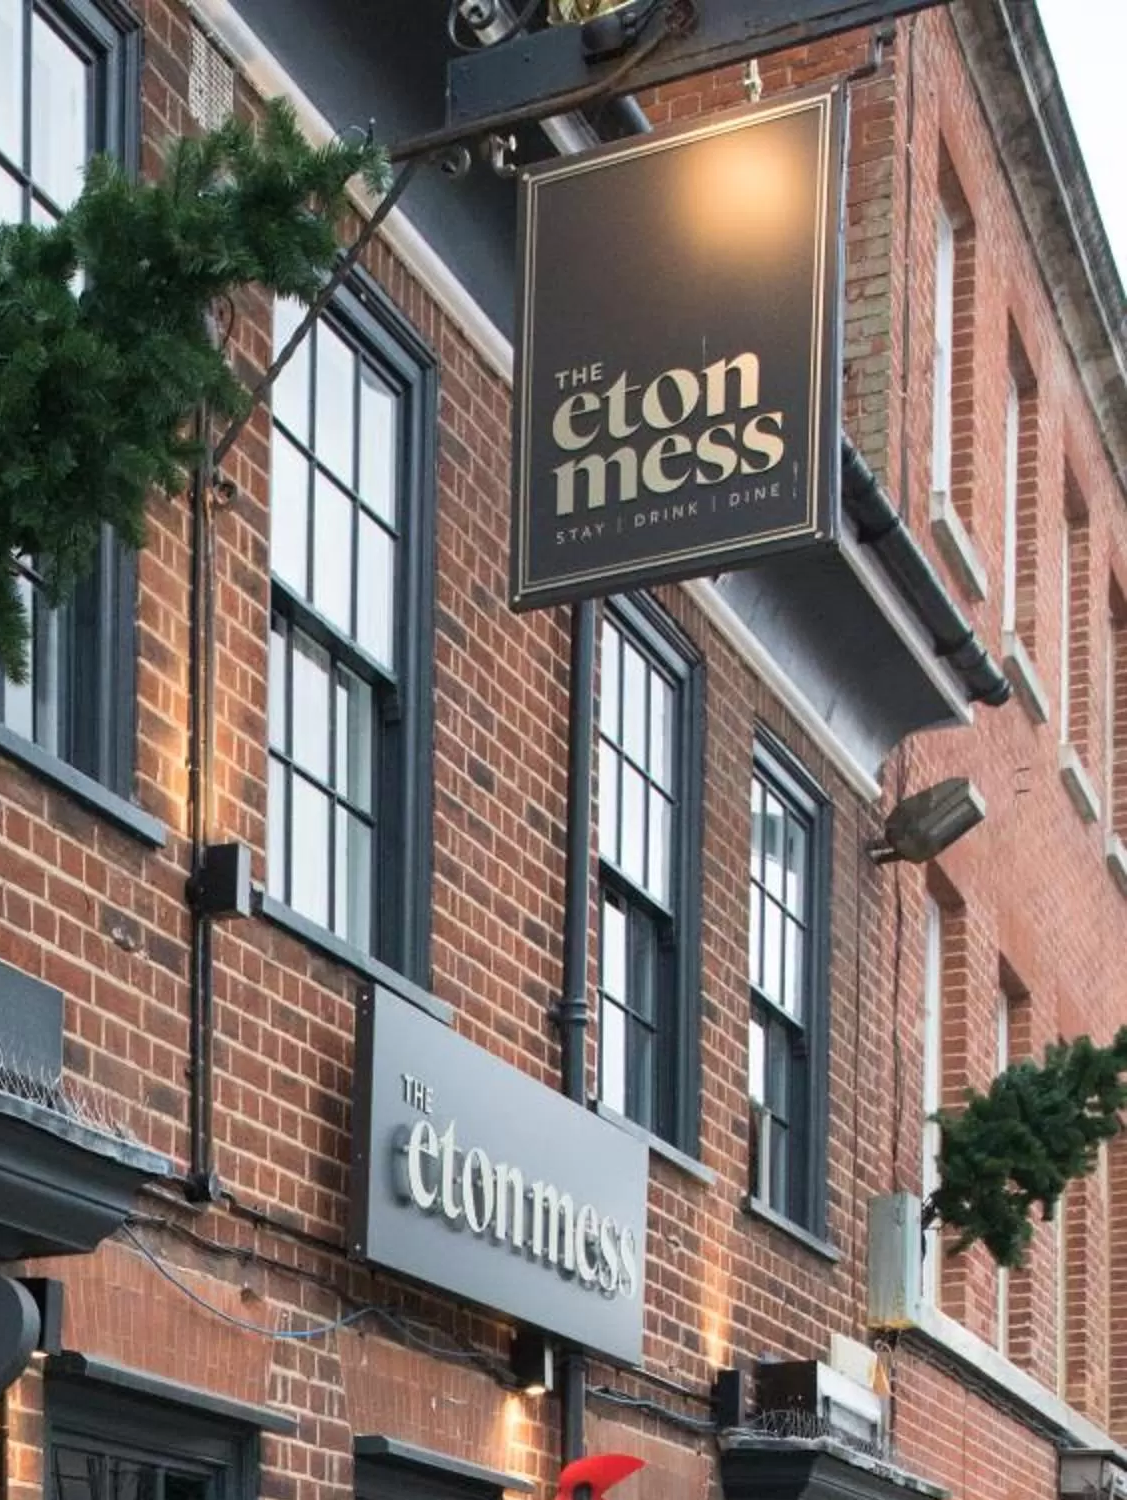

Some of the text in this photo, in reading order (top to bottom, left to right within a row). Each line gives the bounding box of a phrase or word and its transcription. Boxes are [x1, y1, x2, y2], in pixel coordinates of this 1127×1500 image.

[552, 352, 760, 451] eton
[554, 362, 604, 390] THE
[552, 411, 785, 517] mess
[555, 483, 781, 545] STAY DRINK DINE
[401, 1073, 433, 1115] THE
